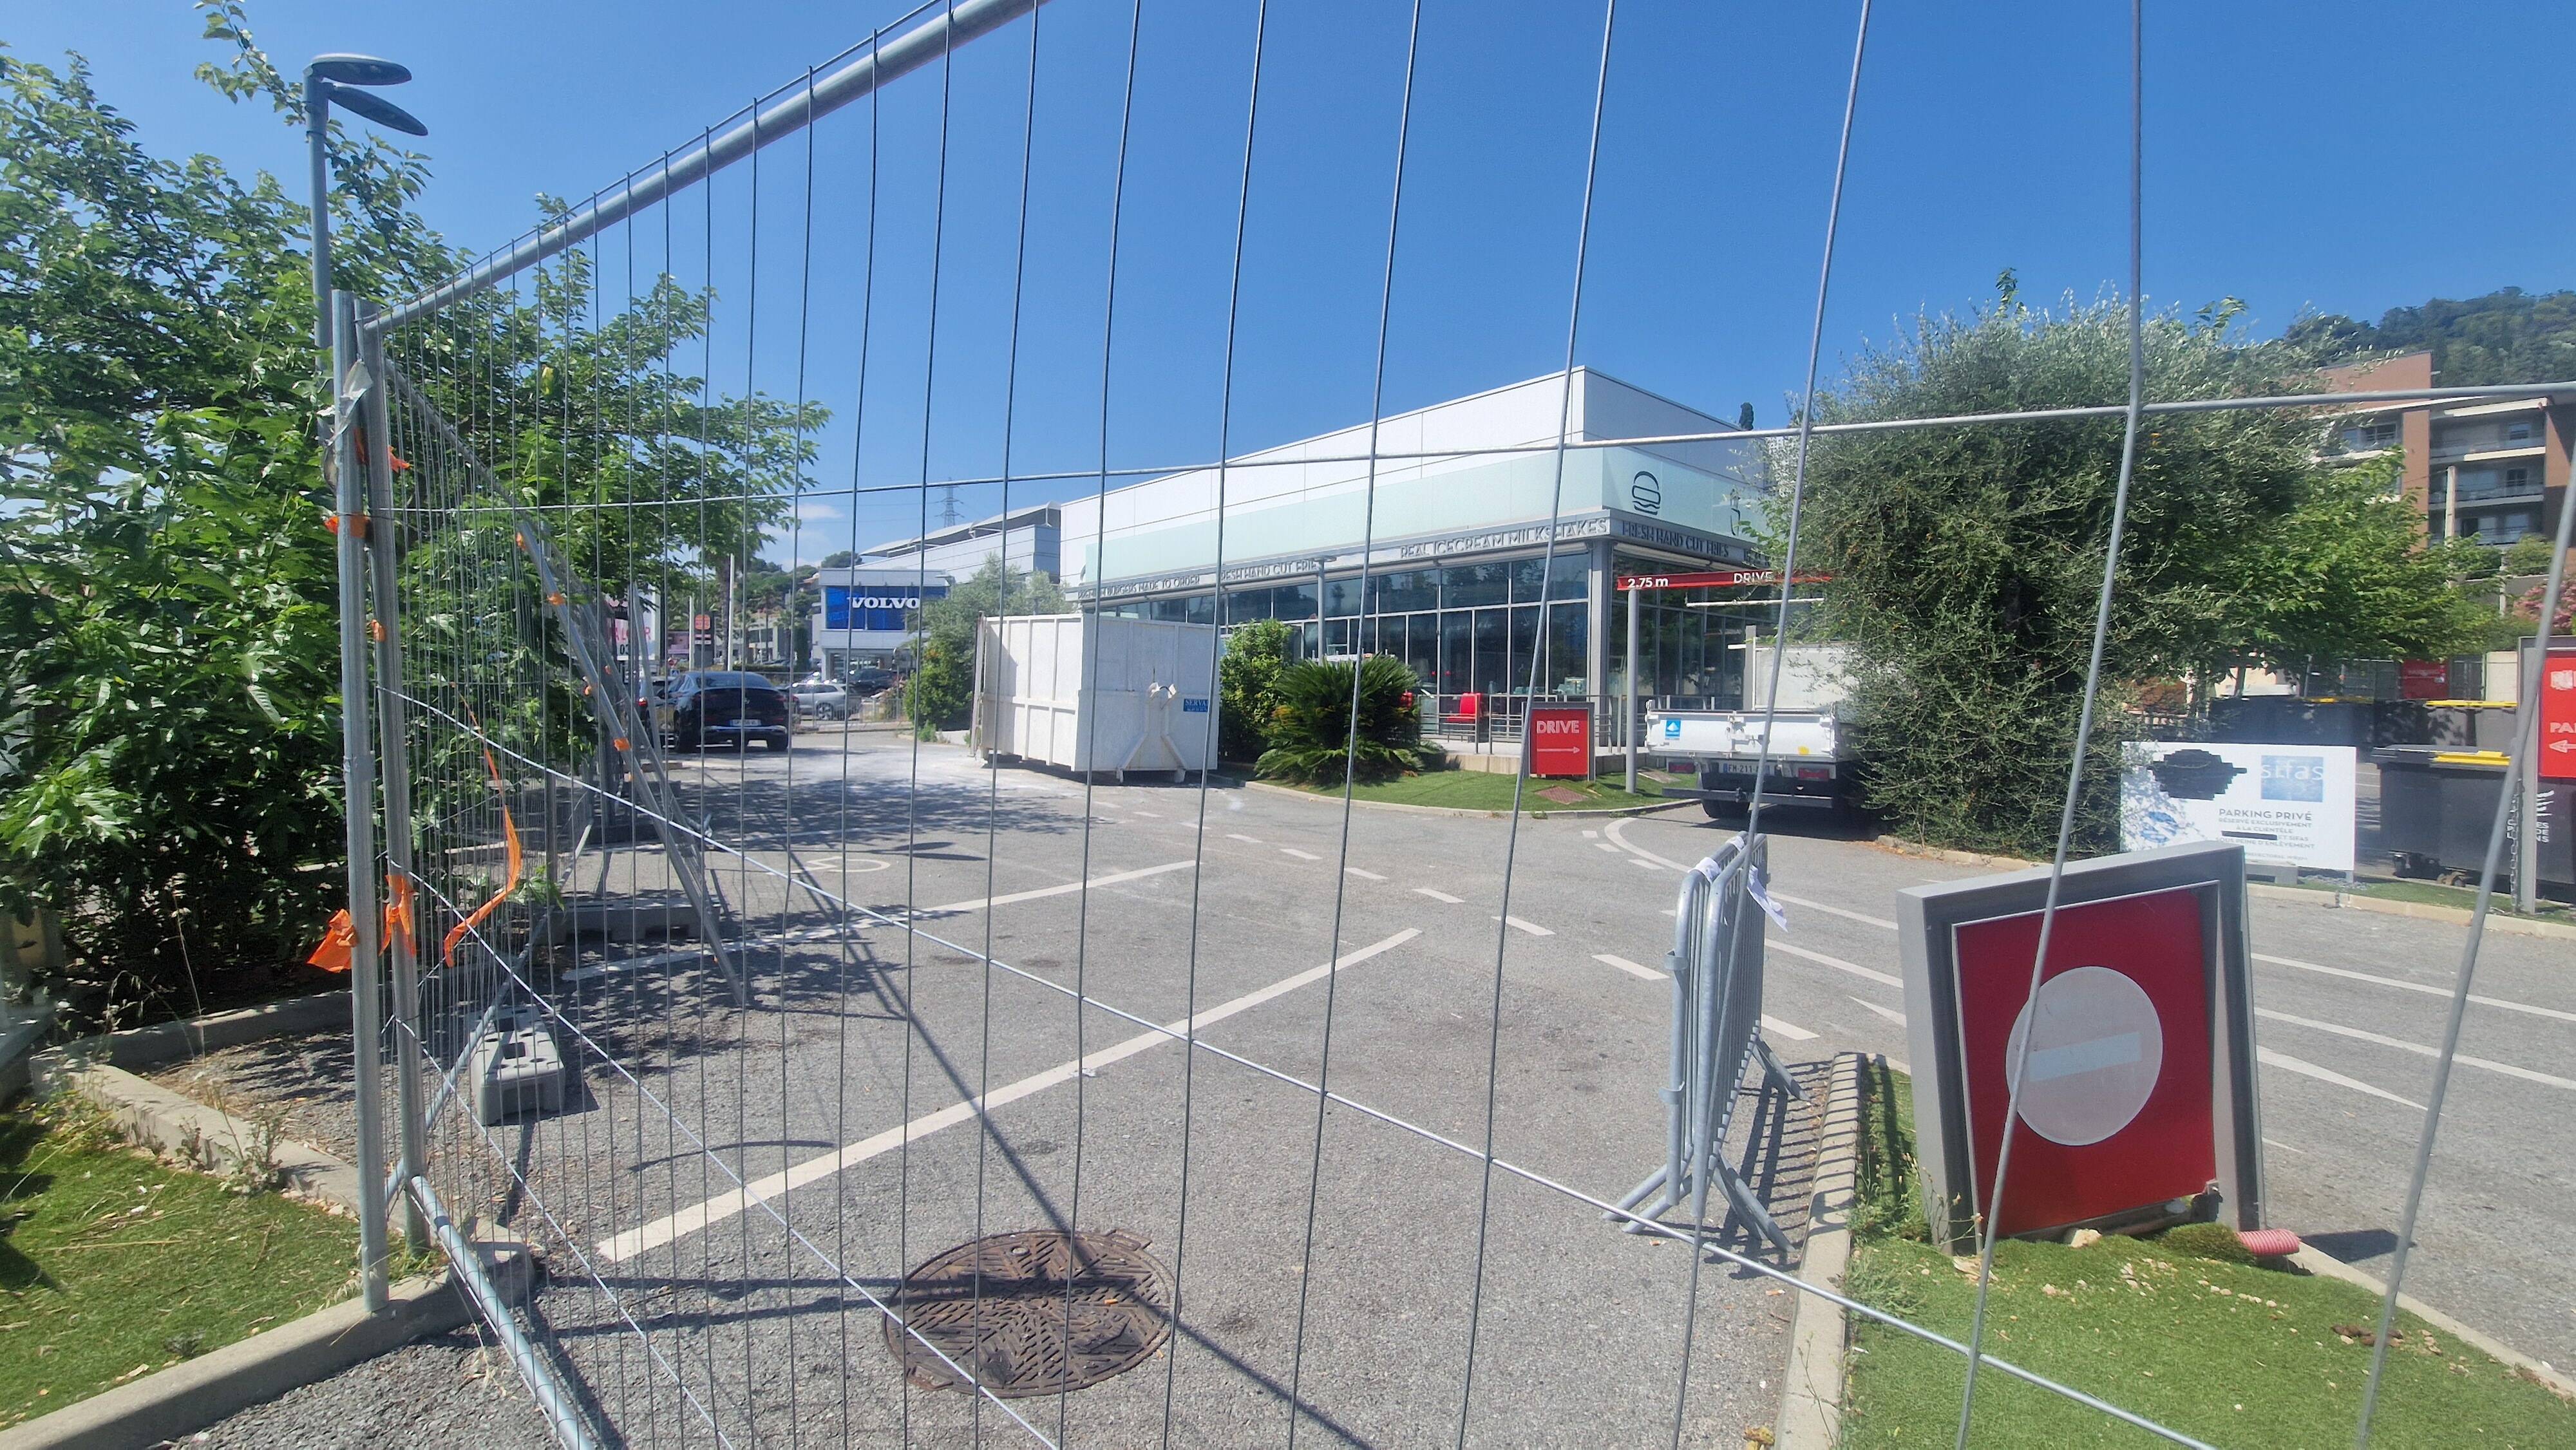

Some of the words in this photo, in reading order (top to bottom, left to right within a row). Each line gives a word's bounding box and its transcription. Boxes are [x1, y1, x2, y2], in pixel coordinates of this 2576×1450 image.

[1400, 541, 1428, 558] REAL
[1508, 518, 1607, 545] MILKSHAKES
[1622, 520, 1654, 542] FRESH
[1656, 528, 1683, 547] HAND
[1686, 535, 1703, 552] CUT
[1707, 540, 1729, 558] FRIES
[1244, 565, 1271, 579] HAND
[1273, 561, 1293, 575] CUT
[1296, 558, 1318, 572] FRIE
[1162, 578, 1171, 589] TO
[1173, 575, 1200, 588] ORDER
[1627, 577, 1653, 588] 2.75
[1656, 577, 1669, 587] m
[847, 597, 921, 608] VOLVO
[1537, 720, 1580, 734] DRIVE
[2550, 722, 2576, 733] PA
[2219, 809, 2271, 818] PARKING
[2276, 811, 2312, 821] PRIVÉ
